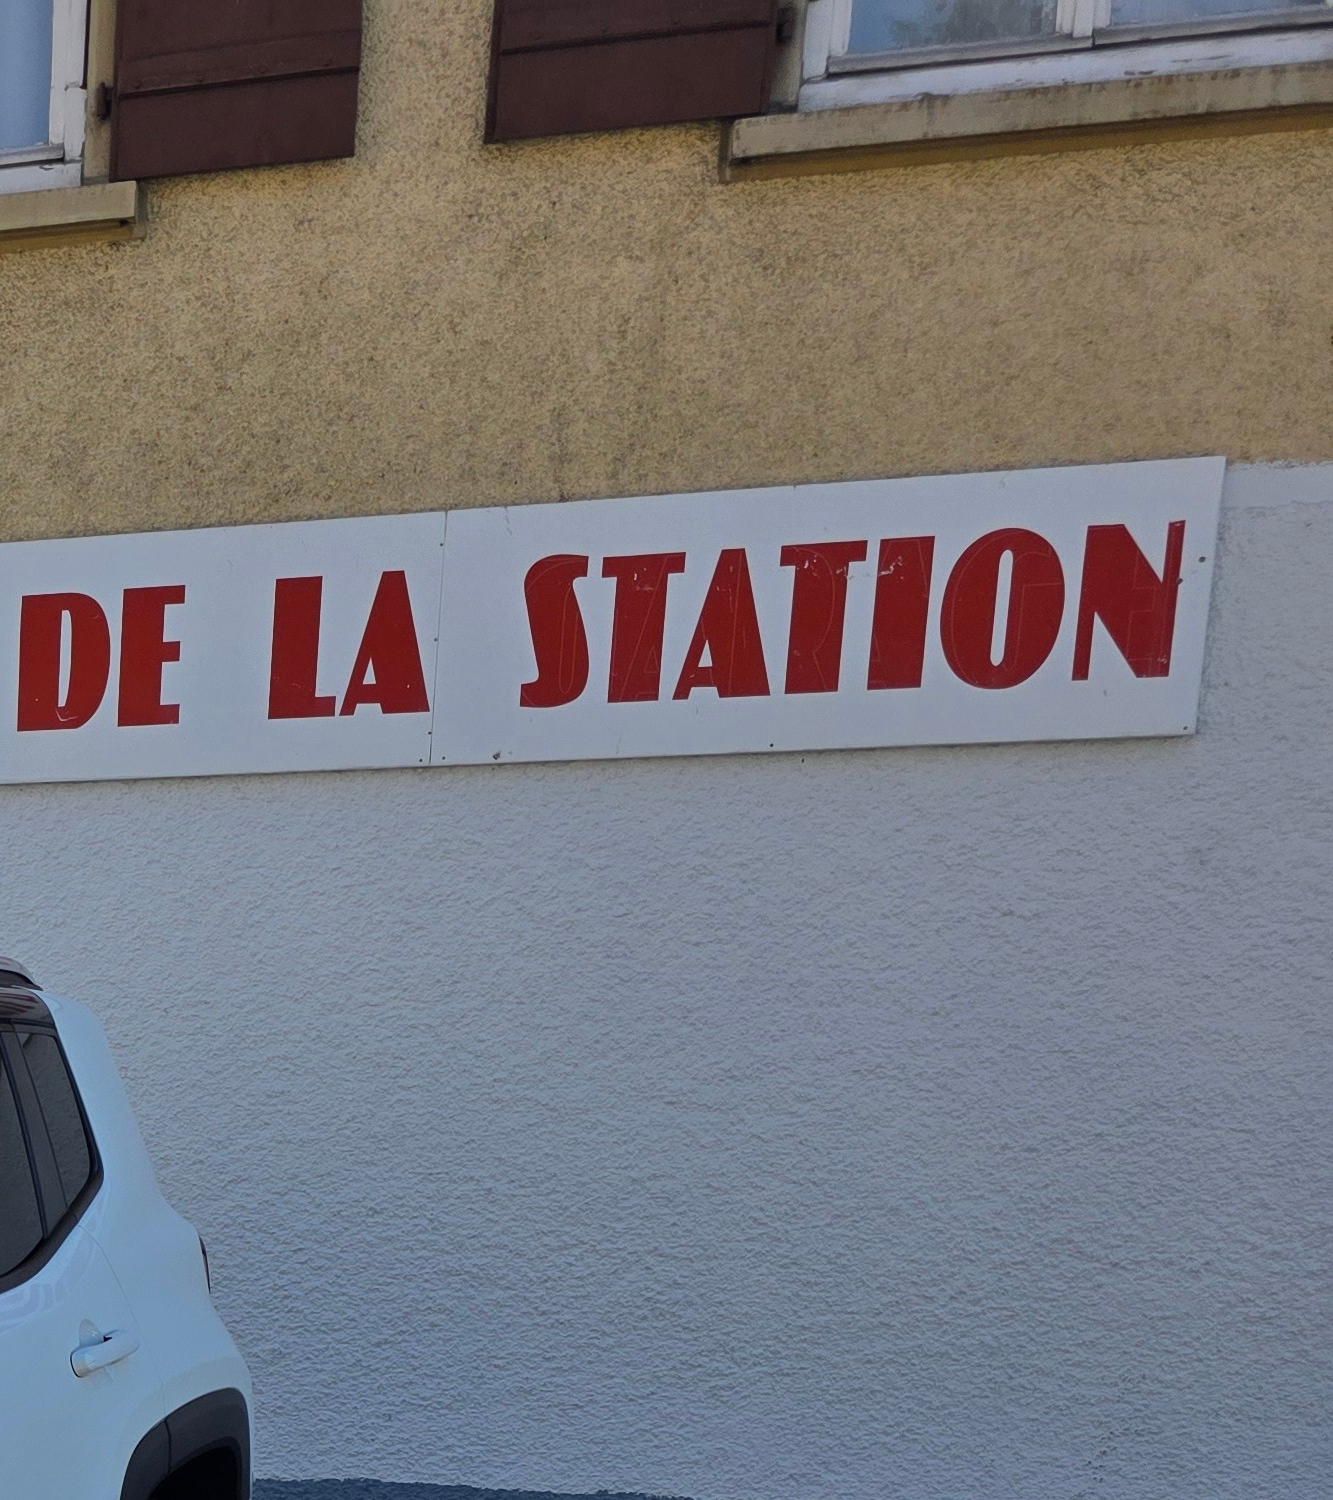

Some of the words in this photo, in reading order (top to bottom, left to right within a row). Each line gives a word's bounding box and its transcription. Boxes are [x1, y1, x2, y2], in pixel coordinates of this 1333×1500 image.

[18, 586, 184, 731] DE
[269, 571, 428, 718] LA
[521, 523, 1184, 707] STATION
